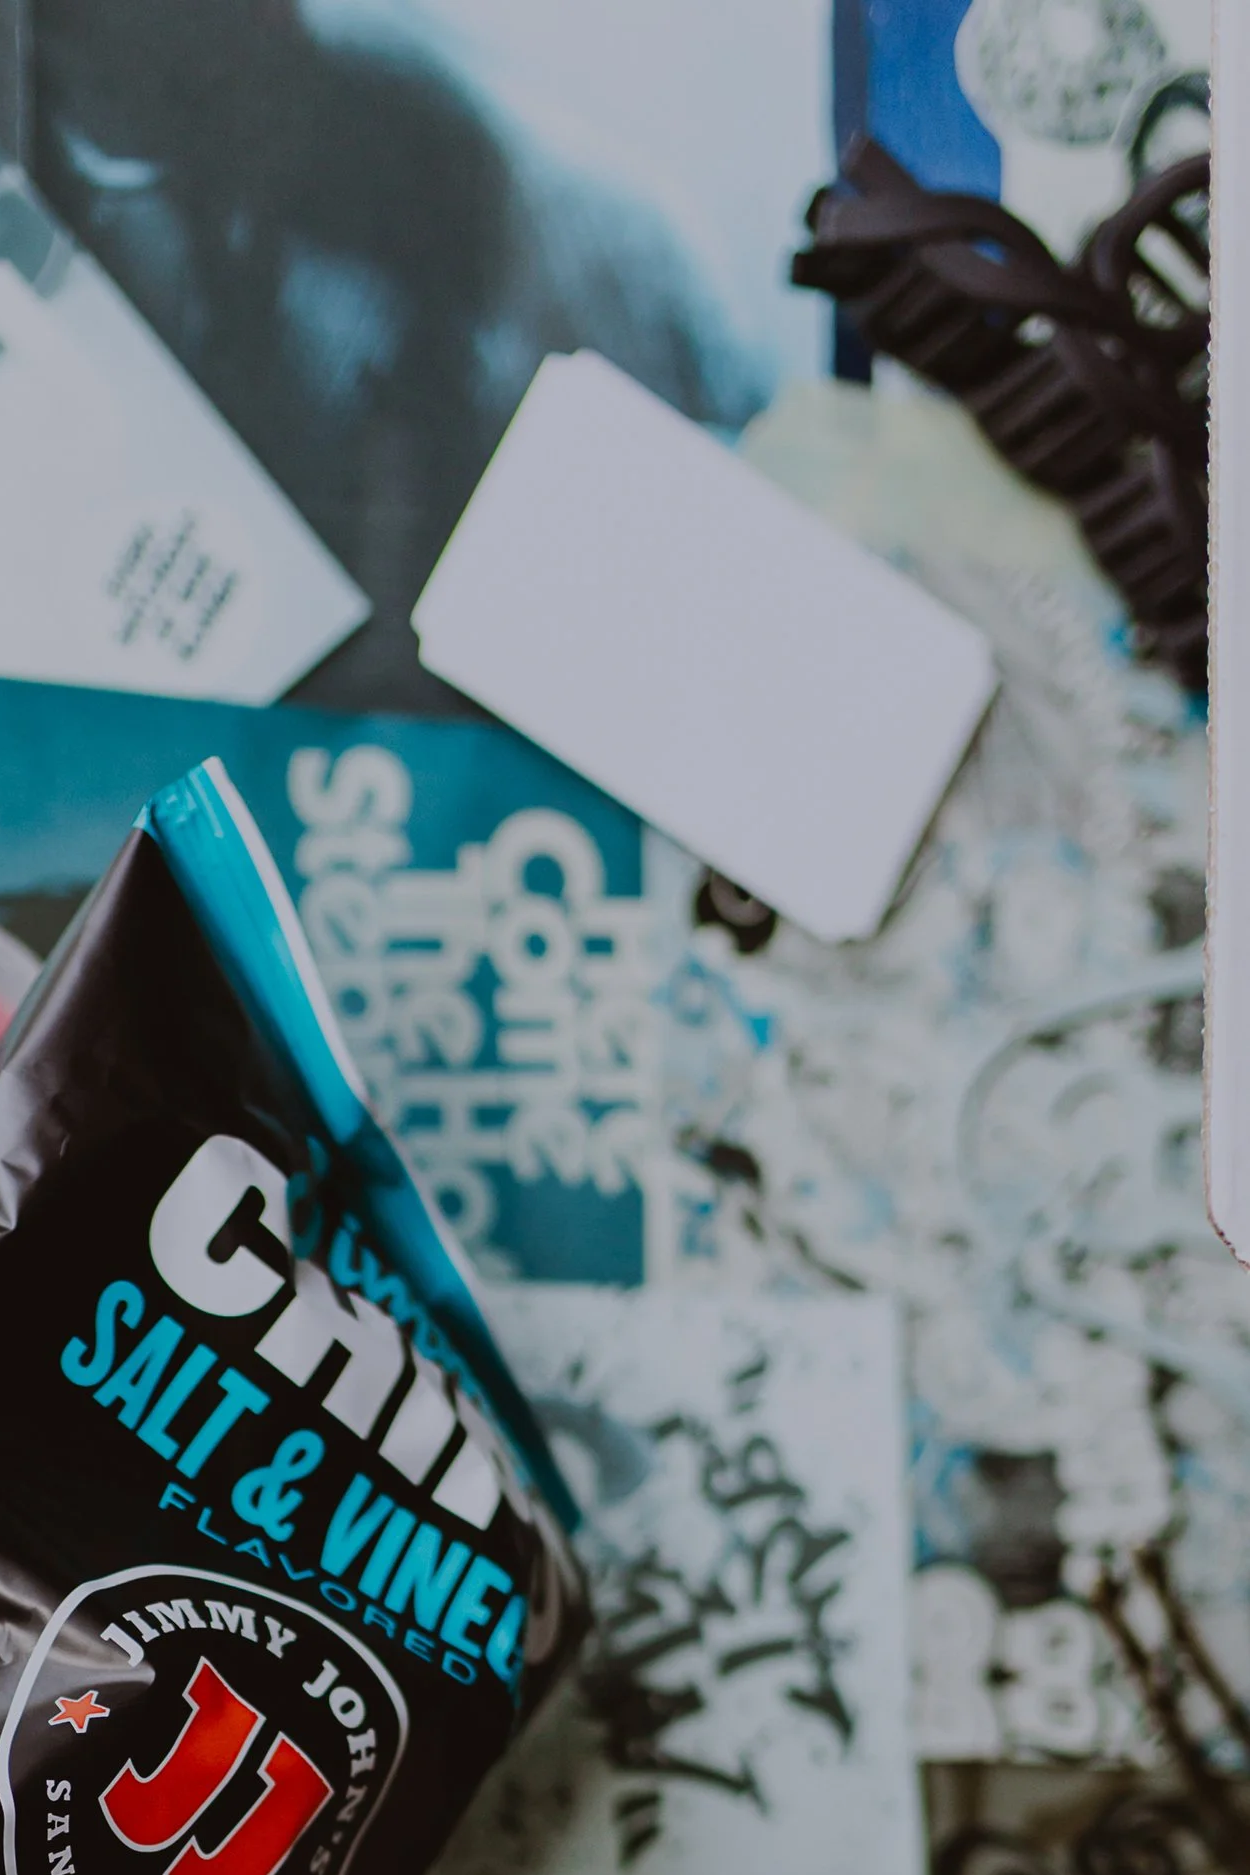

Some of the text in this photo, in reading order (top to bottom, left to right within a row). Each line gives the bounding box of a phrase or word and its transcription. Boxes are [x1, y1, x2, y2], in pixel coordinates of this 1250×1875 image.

[60, 1279, 272, 1479] SALT
[231, 1429, 325, 1542] &
[100, 1598, 298, 1668] JIMMY
[157, 1482, 478, 1686] FLAVORED
